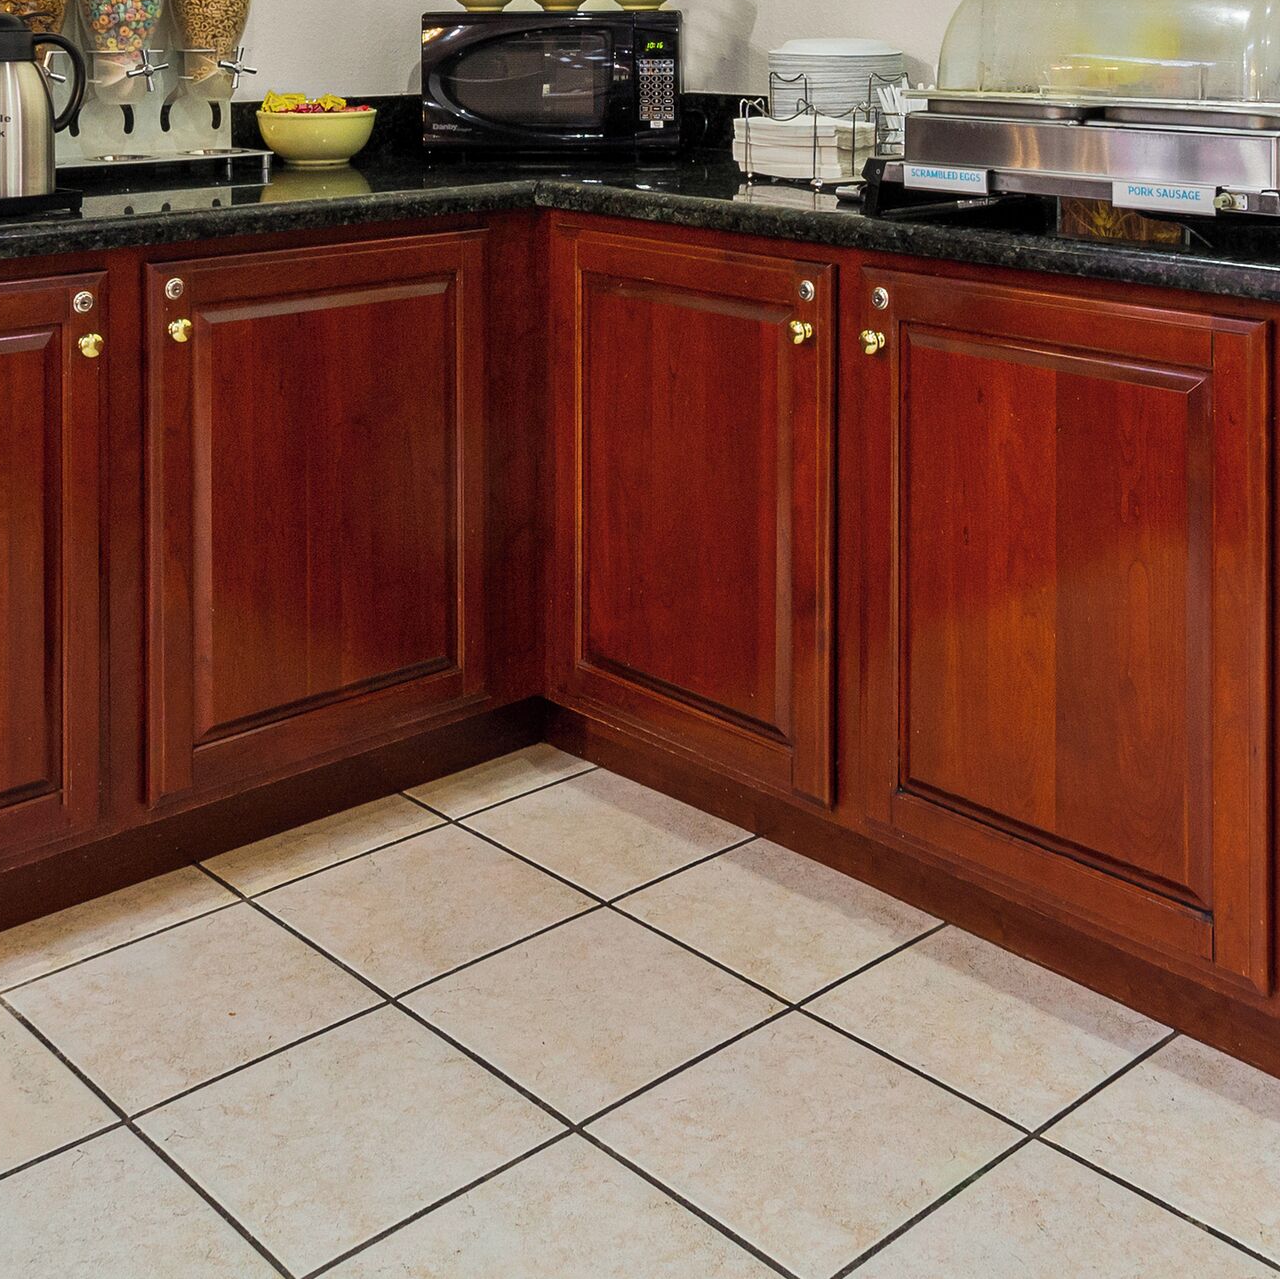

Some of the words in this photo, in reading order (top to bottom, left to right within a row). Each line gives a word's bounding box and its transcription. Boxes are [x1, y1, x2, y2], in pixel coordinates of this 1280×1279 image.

[432, 123, 458, 132] Danby
[911, 168, 958, 180] SCRAMBLED
[960, 171, 982, 182] EGGS
[1128, 185, 1154, 197] PORK
[1156, 188, 1201, 201] SAUSAGE
